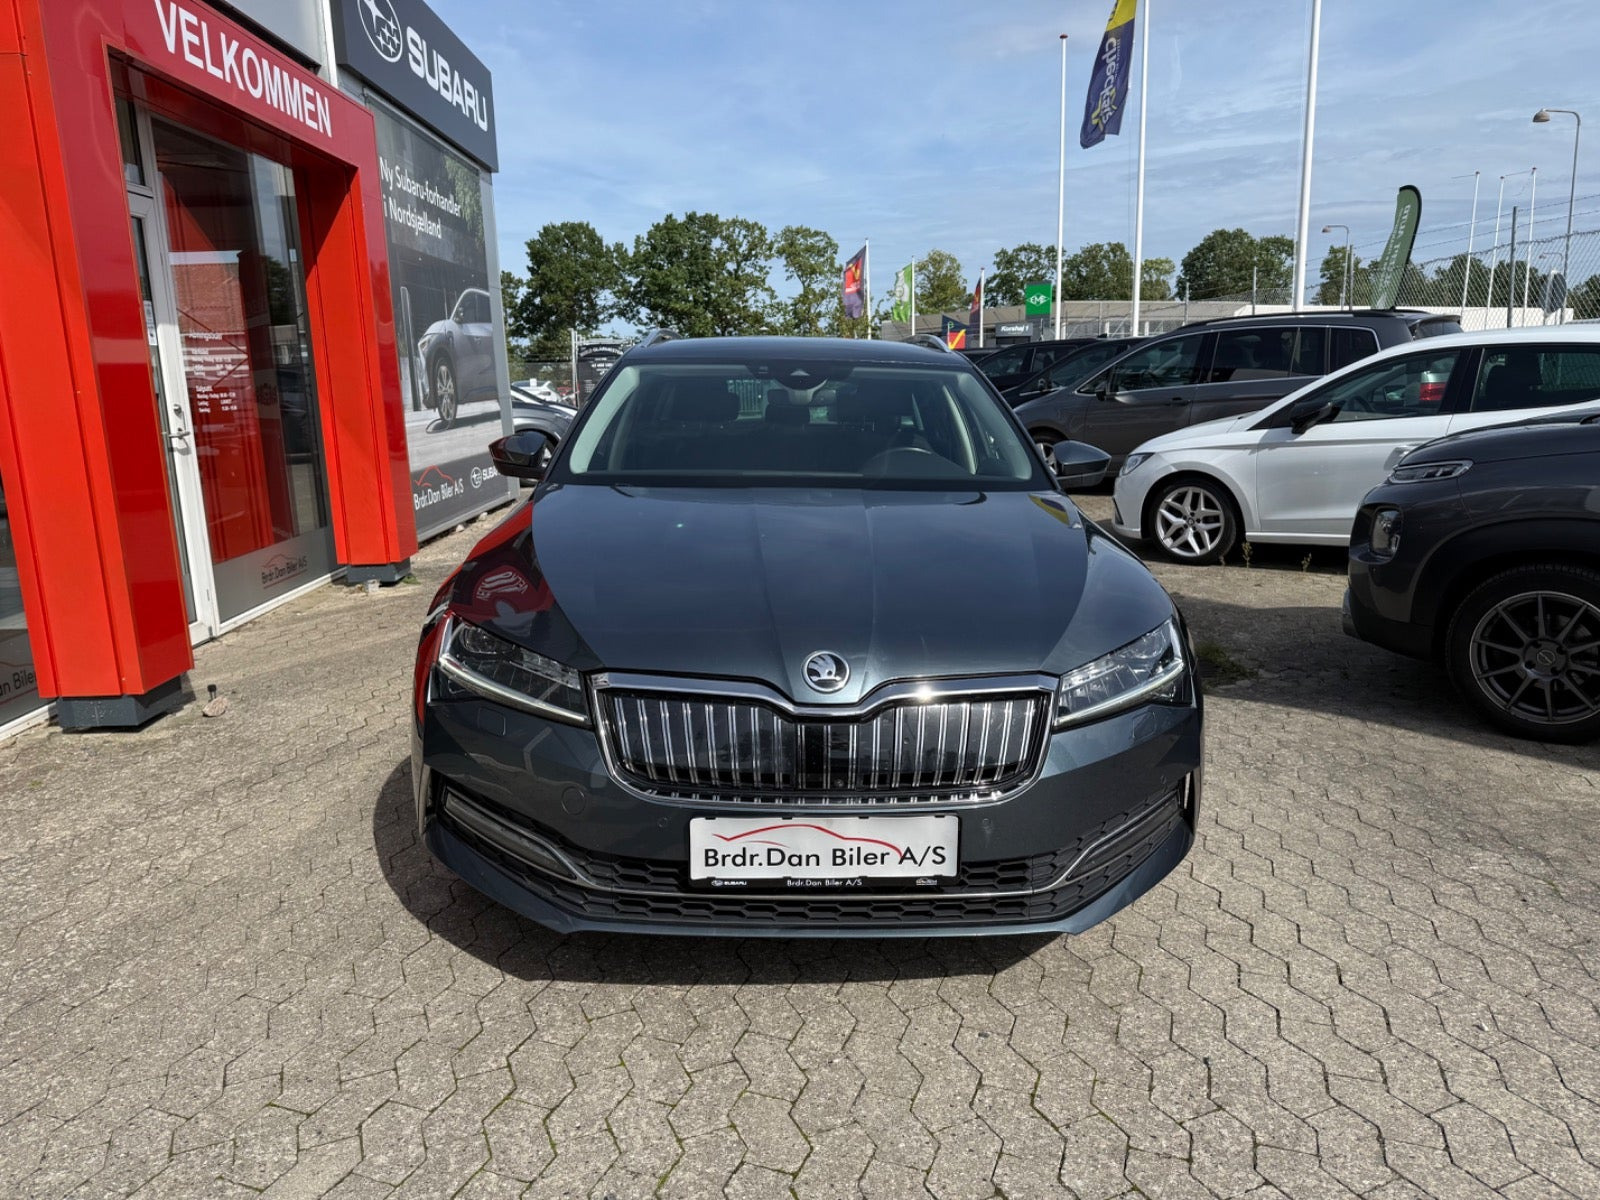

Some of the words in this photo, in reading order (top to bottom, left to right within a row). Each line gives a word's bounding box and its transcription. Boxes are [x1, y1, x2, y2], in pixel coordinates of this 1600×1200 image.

[154, 0, 332, 138] VELKOMMEN
[406, 26, 488, 132] SUBARU
[380, 156, 393, 191] Ny
[395, 165, 461, 217] Subaru-forhandler
[382, 194, 388, 218] i
[389, 196, 442, 239] Nordsjælland
[440, 482, 454, 500] Biler
[12, 669, 37, 690] Bile
[704, 847, 820, 867] Brdr.Dan
[832, 846, 890, 867] Biler
[898, 846, 946, 867] A/S
[845, 878, 863, 886] A/S
